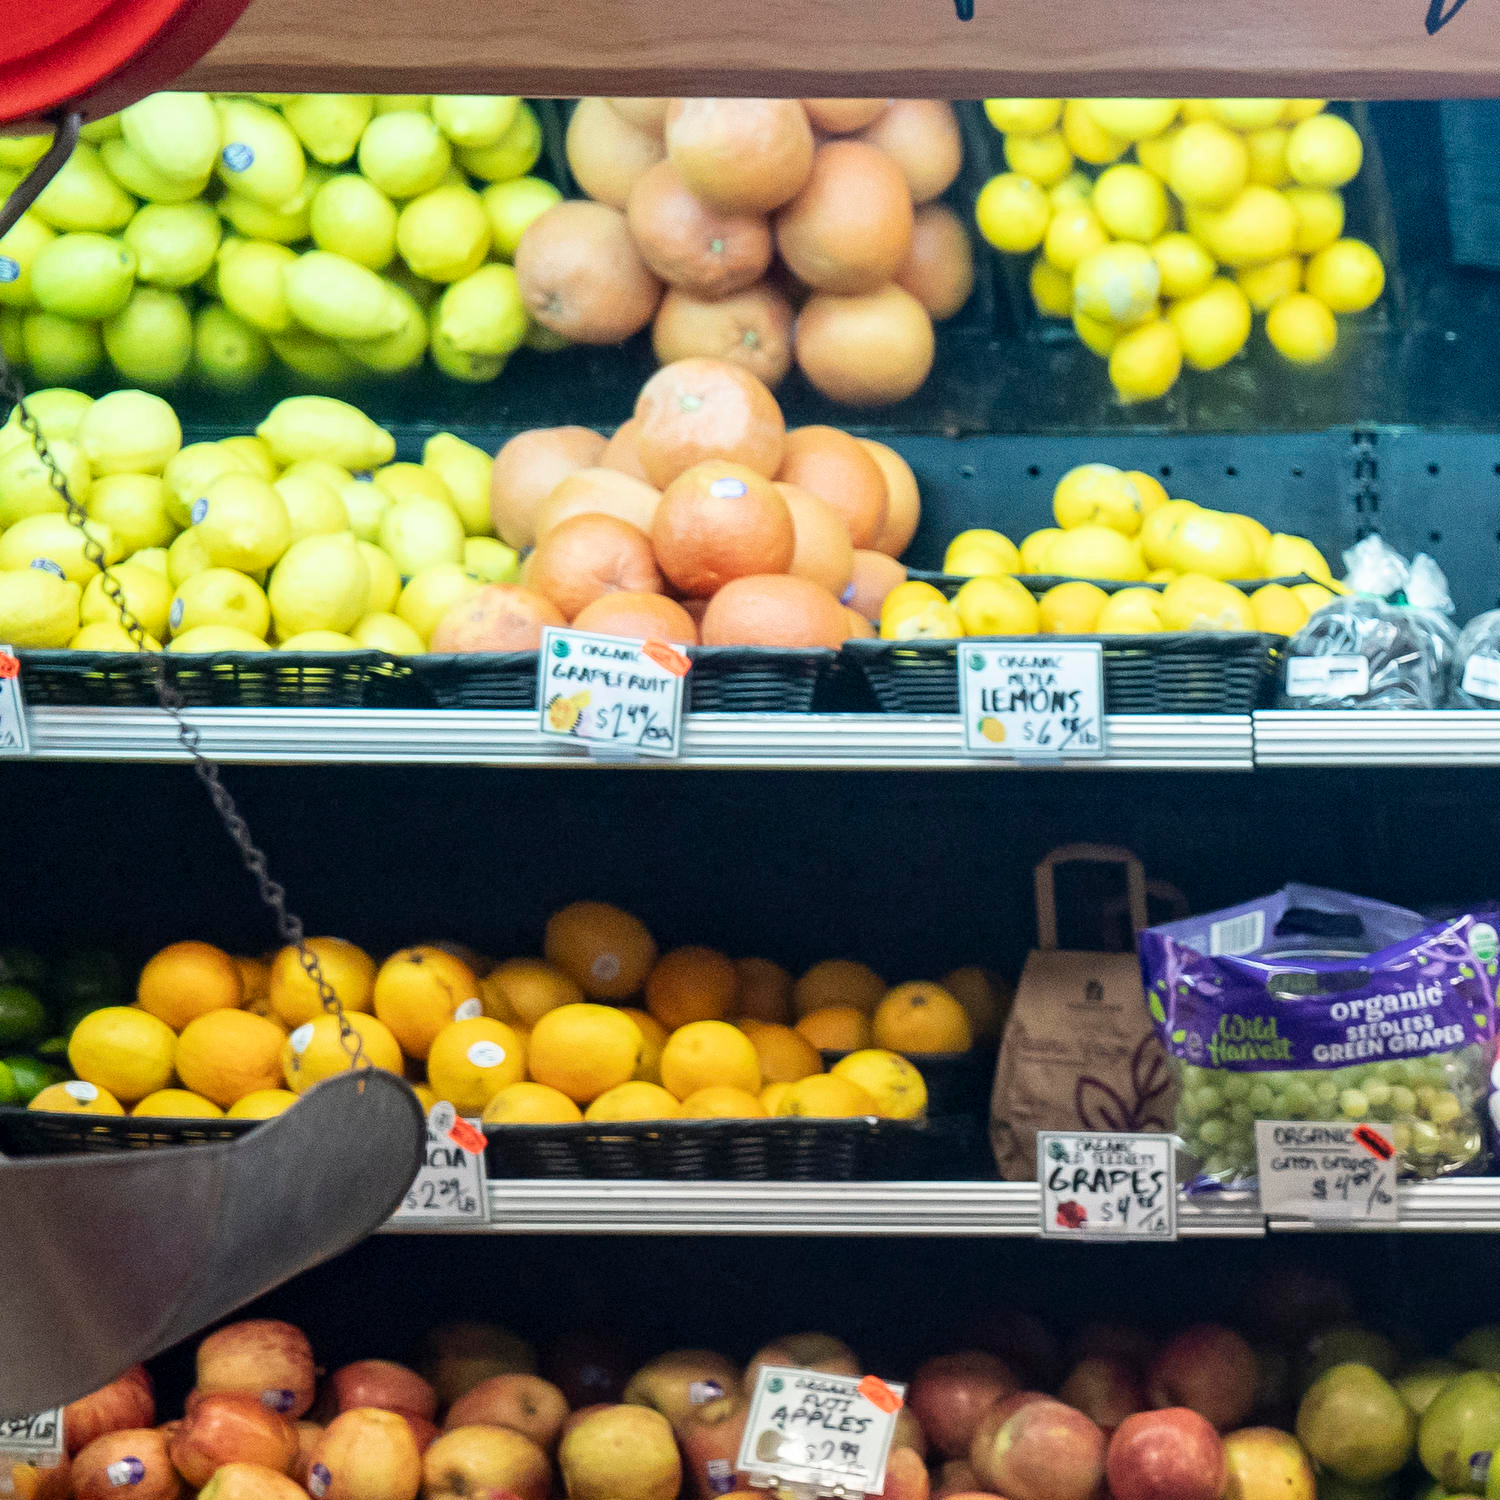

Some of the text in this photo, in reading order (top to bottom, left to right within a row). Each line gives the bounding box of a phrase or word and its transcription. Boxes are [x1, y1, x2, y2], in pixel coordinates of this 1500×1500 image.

[552, 663, 670, 693] GRAPEFRUIT
[981, 687, 1082, 713] LEMONS
[1329, 981, 1444, 1024] organic
[1219, 1013, 1279, 1043] Wild
[1345, 1013, 1436, 1043] SEEDLESS
[1208, 1033, 1295, 1065] Harvest
[1312, 1024, 1466, 1063] GREEN GRAPES
[1048, 1166, 1166, 1195] GRAPES
[770, 1405, 874, 1434] APPLES
